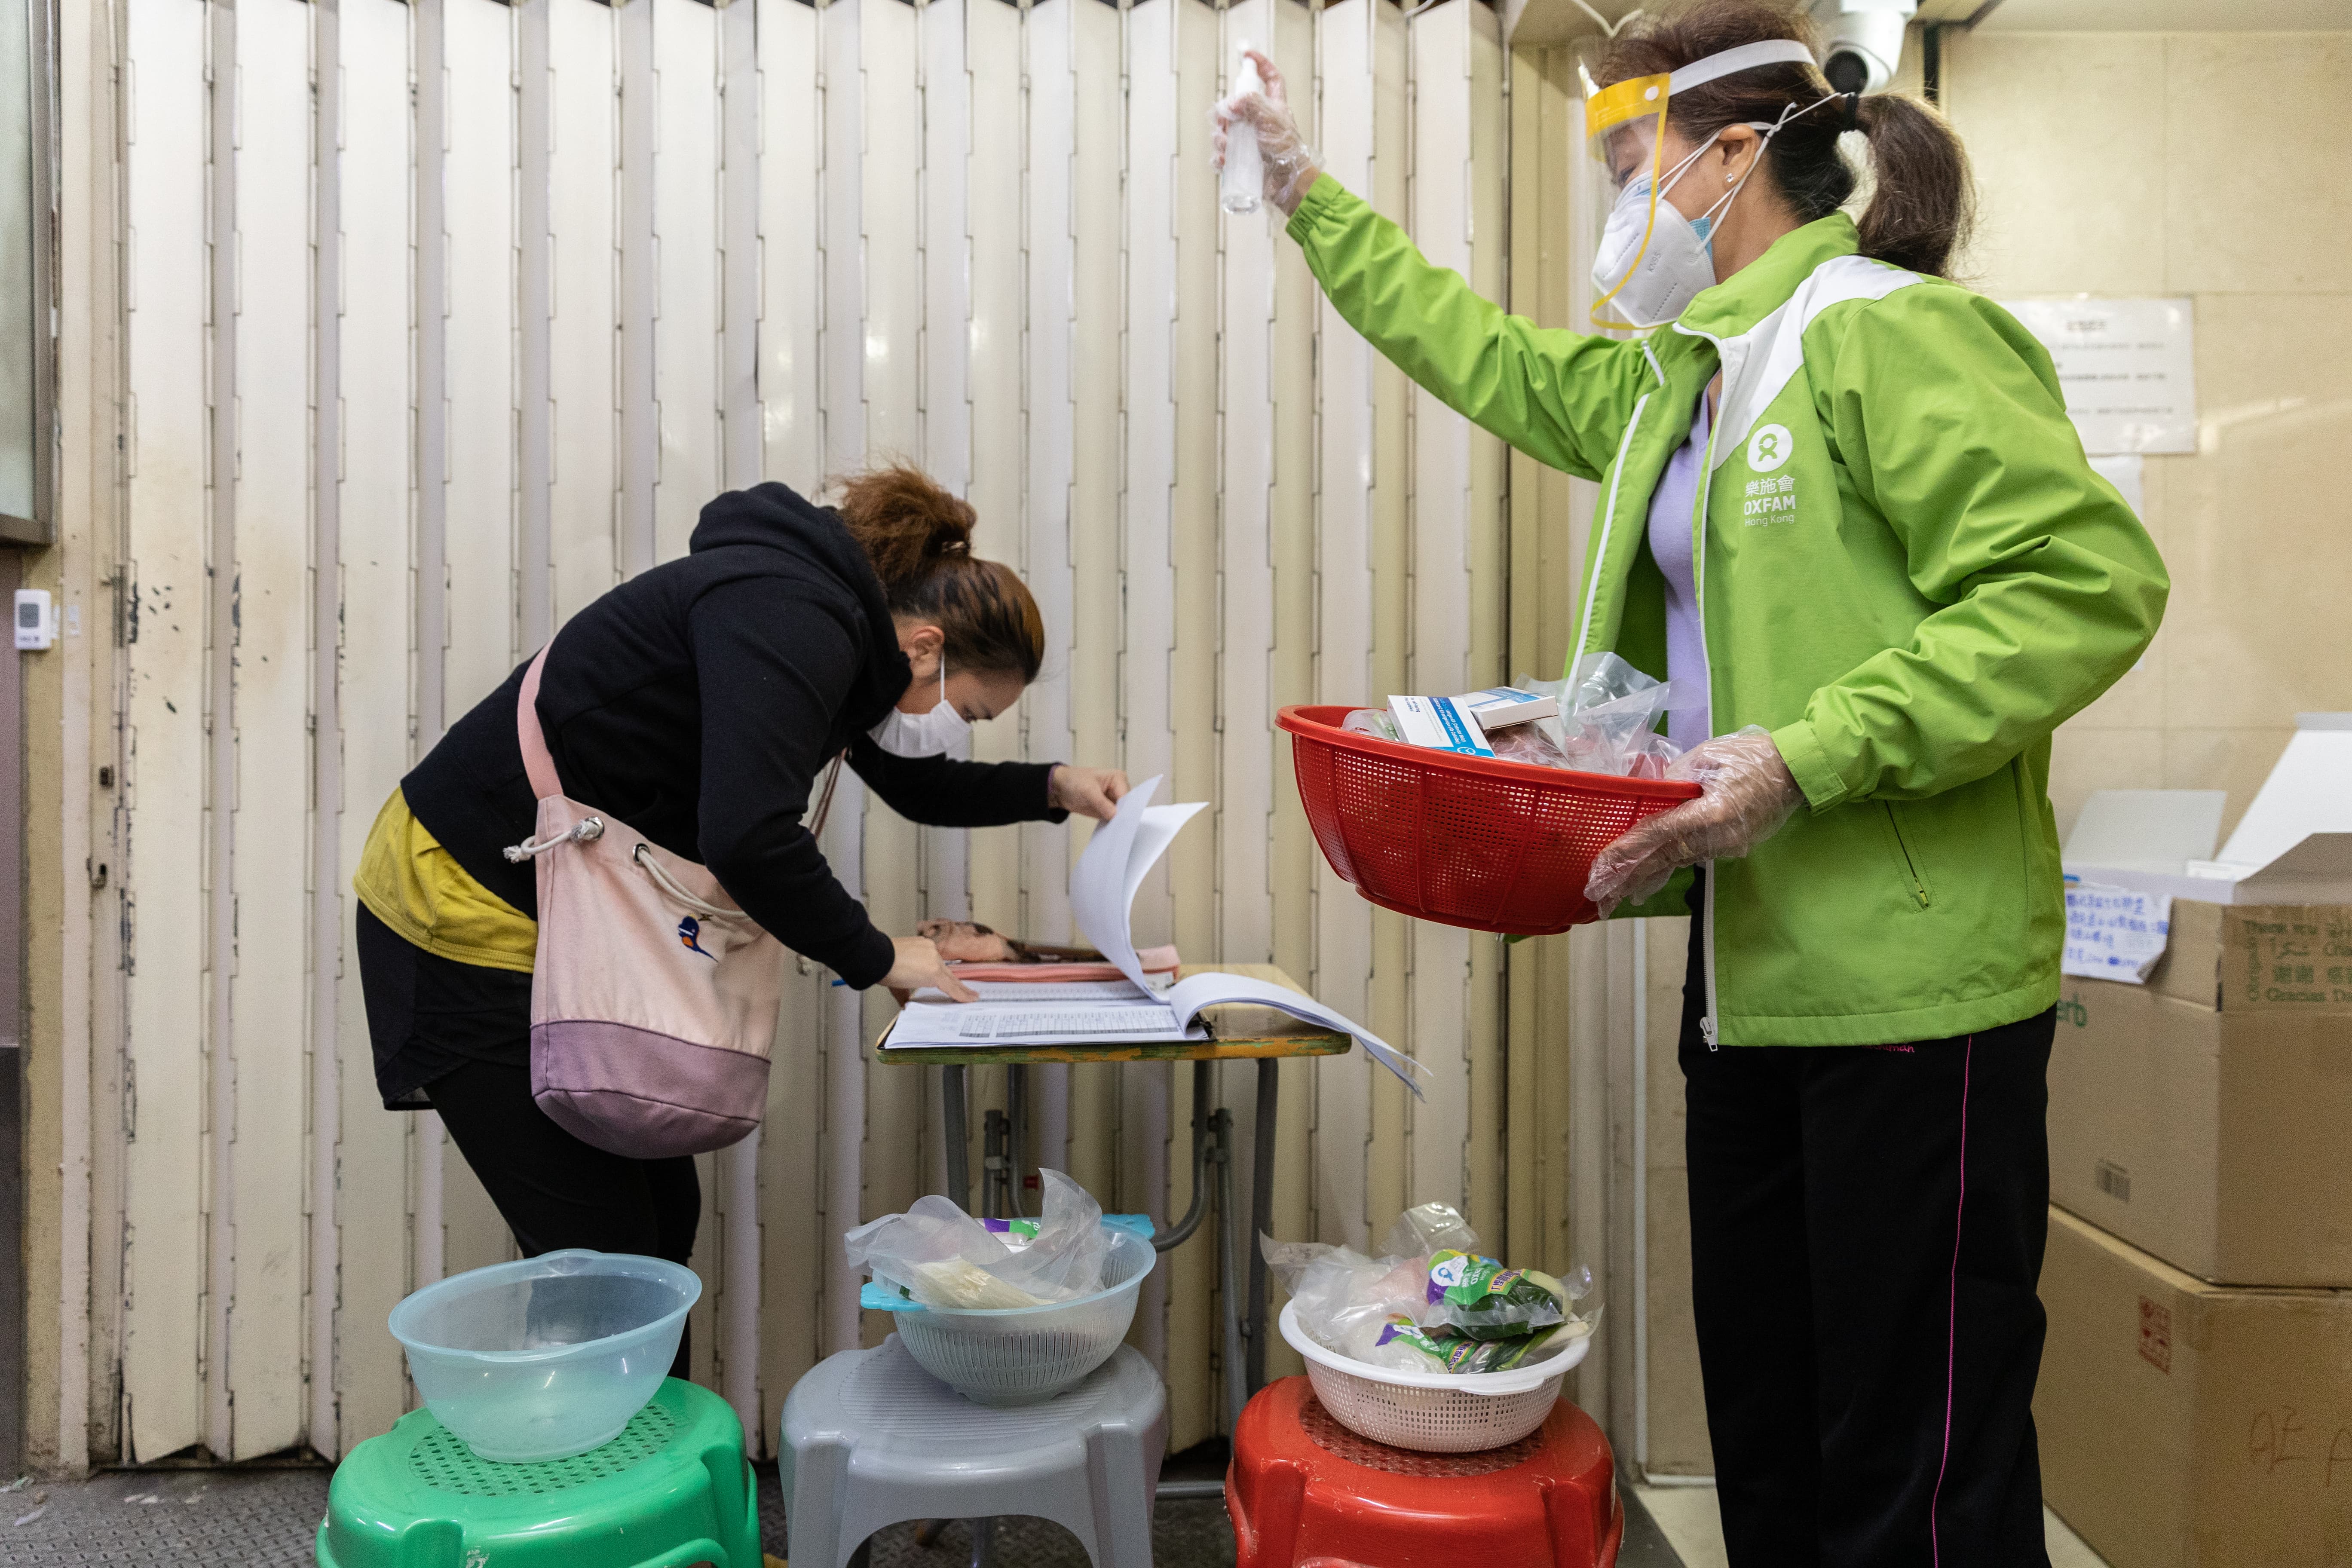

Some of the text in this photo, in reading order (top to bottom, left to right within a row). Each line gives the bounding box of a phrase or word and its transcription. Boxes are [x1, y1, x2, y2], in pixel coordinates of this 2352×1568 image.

[1647, 251, 1662, 273] KN95
[1745, 475, 1795, 497] 樂施會
[1744, 495, 1795, 515] OXFAM
[1745, 514, 1794, 527] Hong Kong
